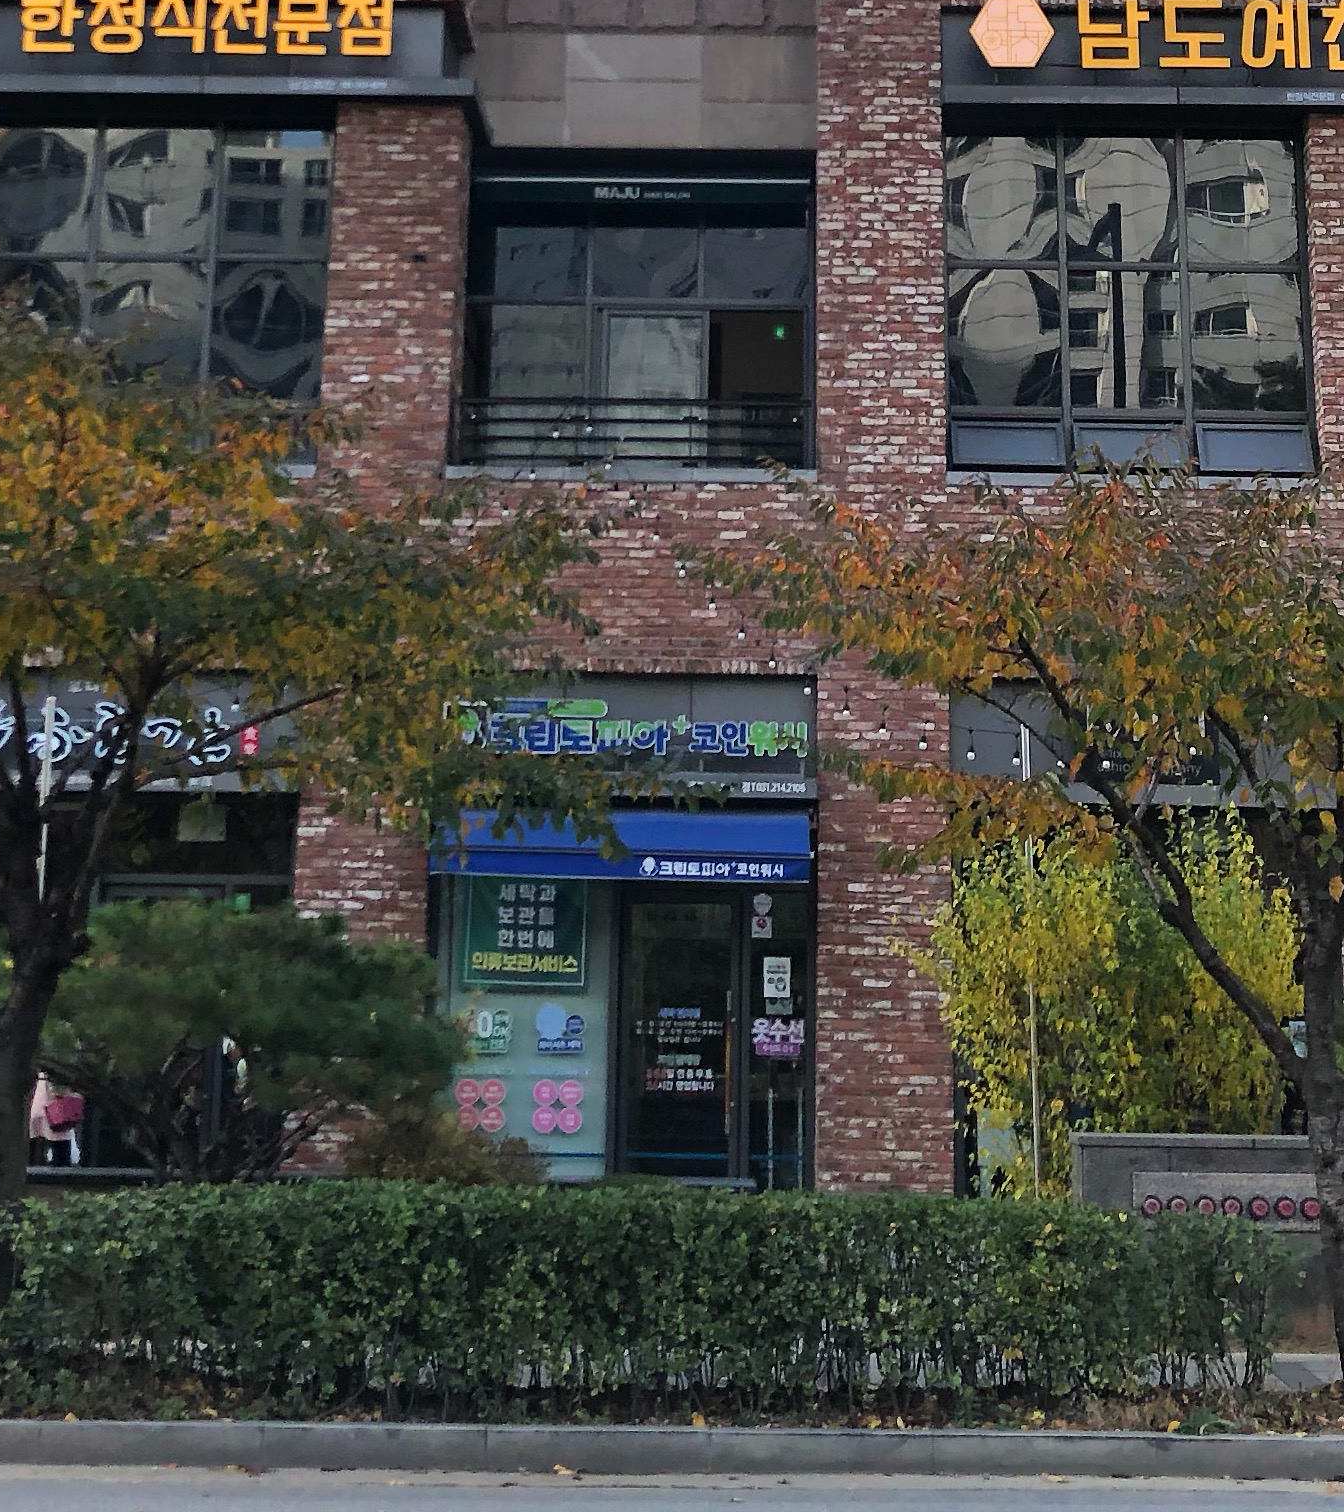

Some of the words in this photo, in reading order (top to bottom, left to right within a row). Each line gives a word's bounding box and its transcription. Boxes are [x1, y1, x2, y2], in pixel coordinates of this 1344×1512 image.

[593, 186, 641, 200] MAJU
[498, 884, 557, 902] 세탁과
[497, 929, 555, 949] 한번에
[471, 951, 579, 973] 의류보관서비스
